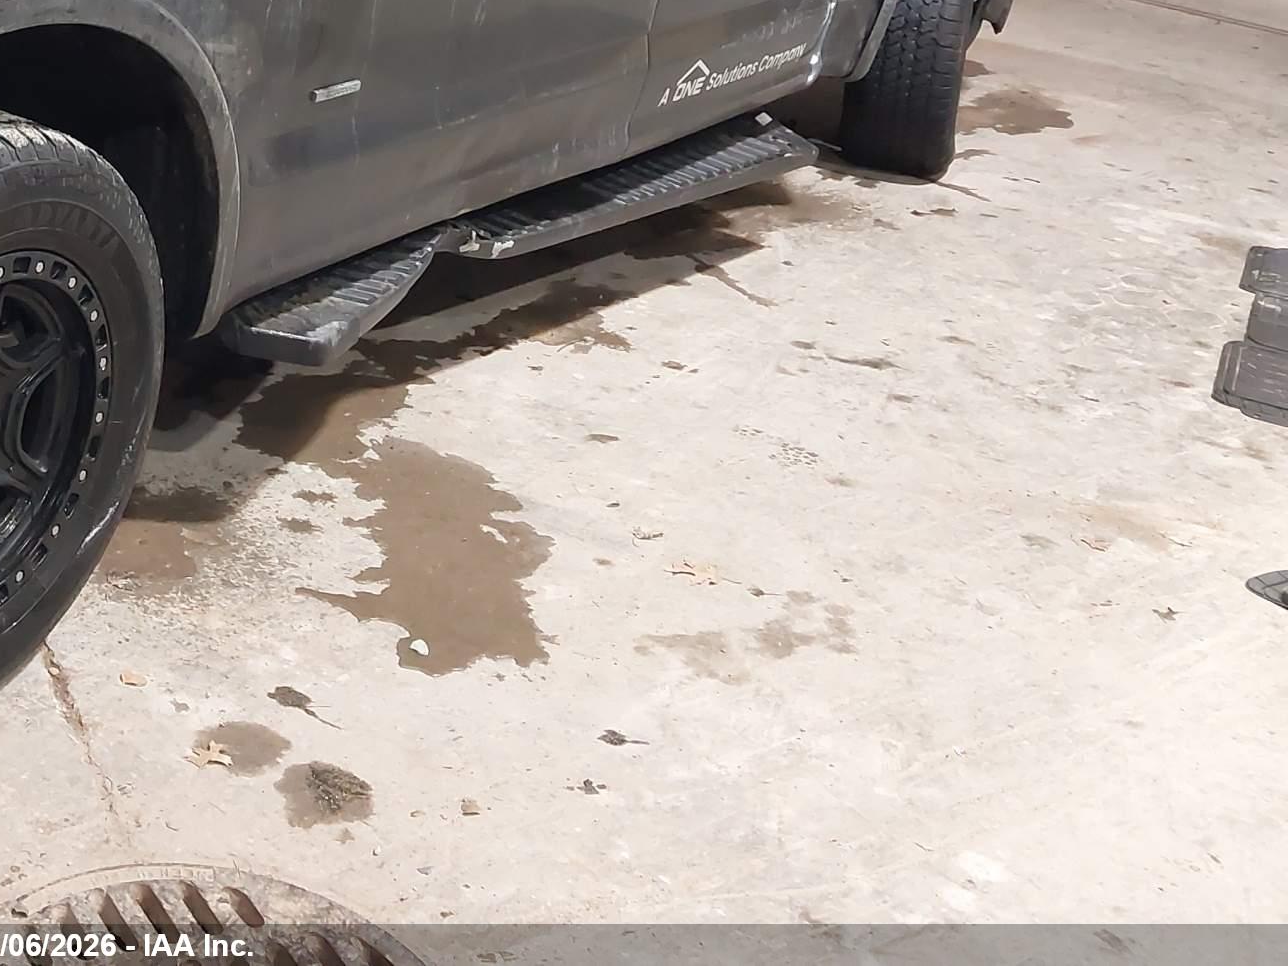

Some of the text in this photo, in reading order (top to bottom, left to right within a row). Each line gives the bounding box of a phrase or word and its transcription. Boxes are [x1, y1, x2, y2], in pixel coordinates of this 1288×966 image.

[657, 87, 670, 107] A
[706, 62, 758, 90] Solutions
[758, 43, 807, 73] Company
